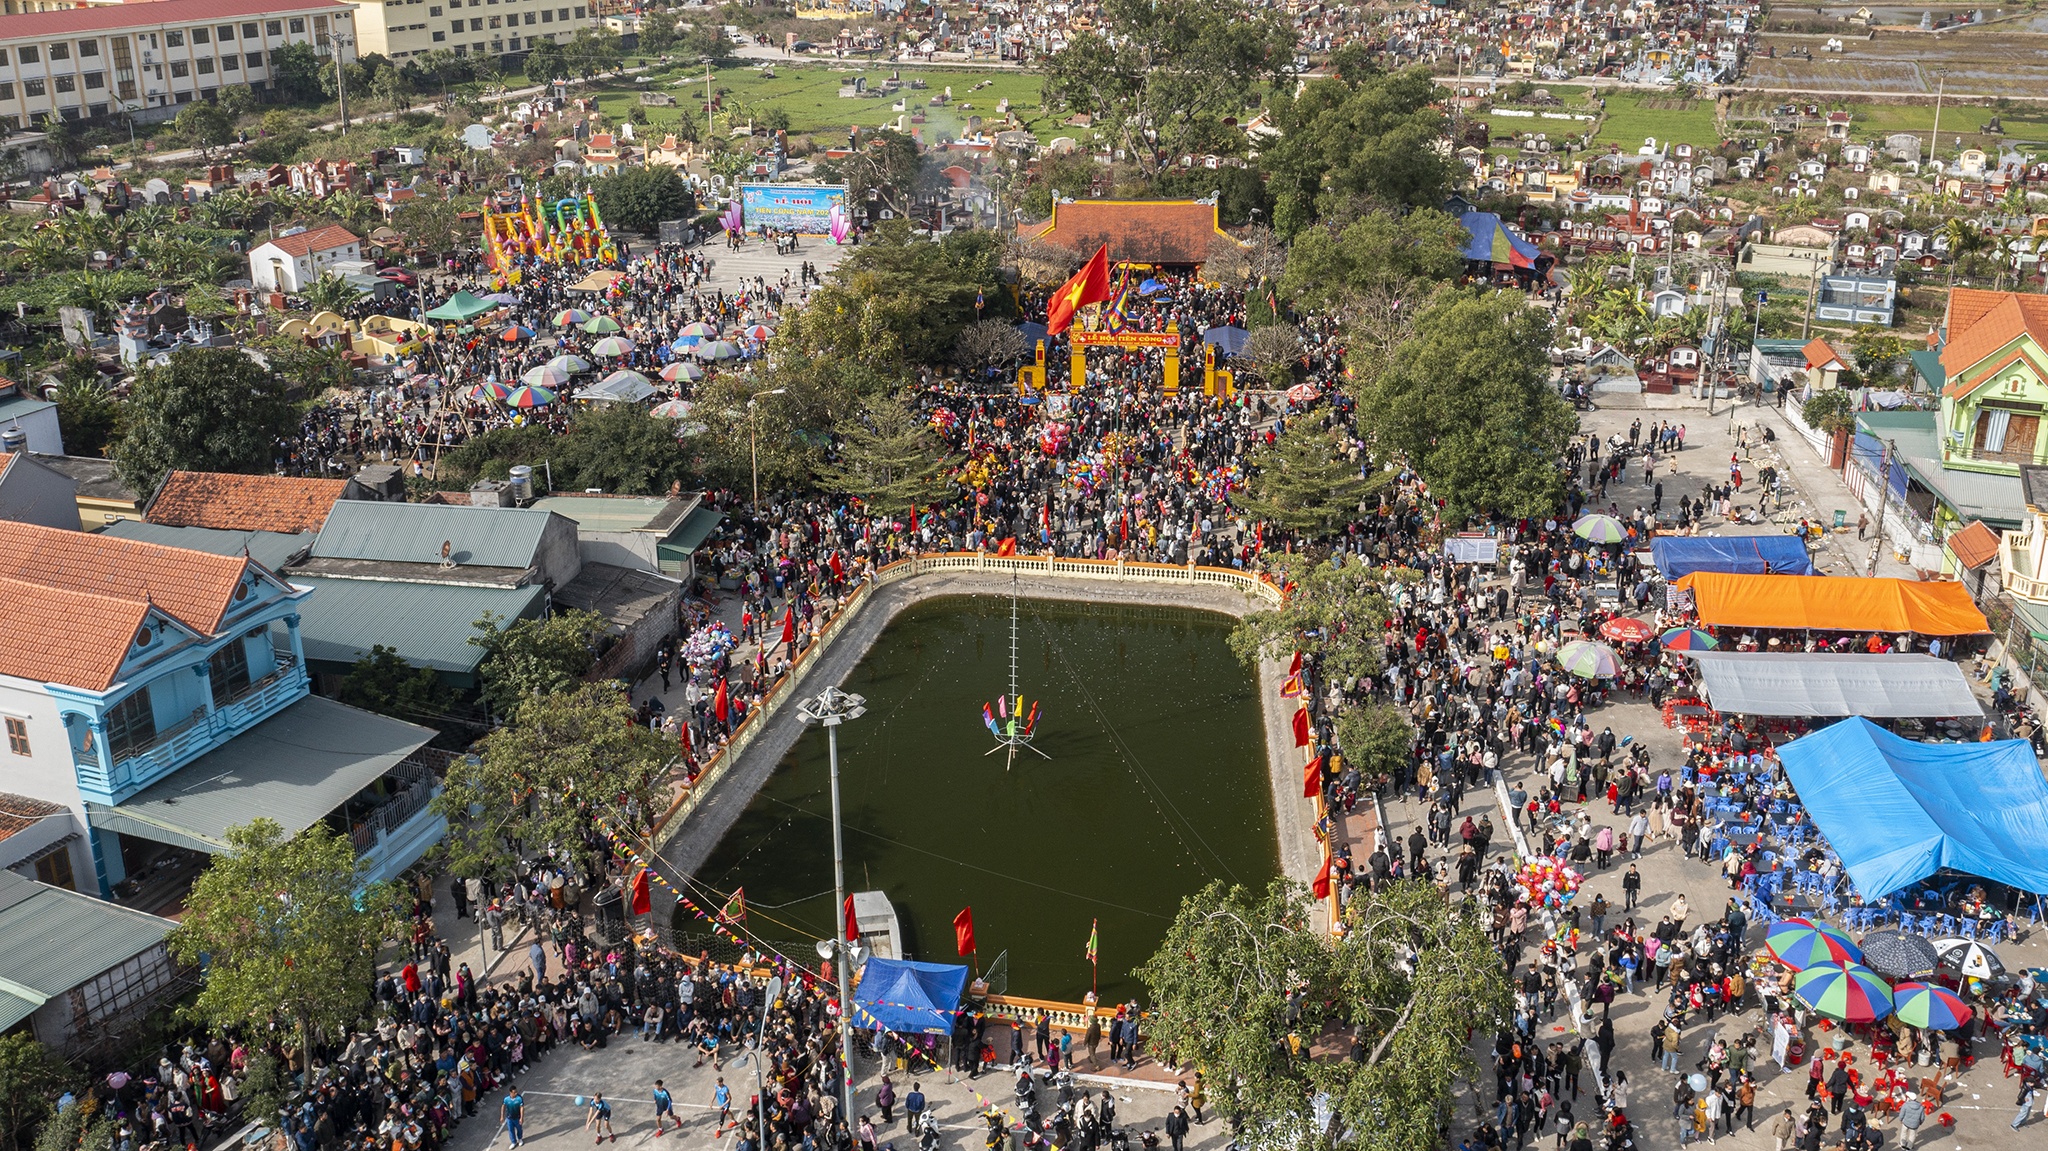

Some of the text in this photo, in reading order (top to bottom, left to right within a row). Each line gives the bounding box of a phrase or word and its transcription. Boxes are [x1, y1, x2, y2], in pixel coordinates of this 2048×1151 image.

[791, 197, 813, 206] HỘI
[773, 207, 795, 215] CÔNG
[1118, 334, 1137, 342] TIÊN
